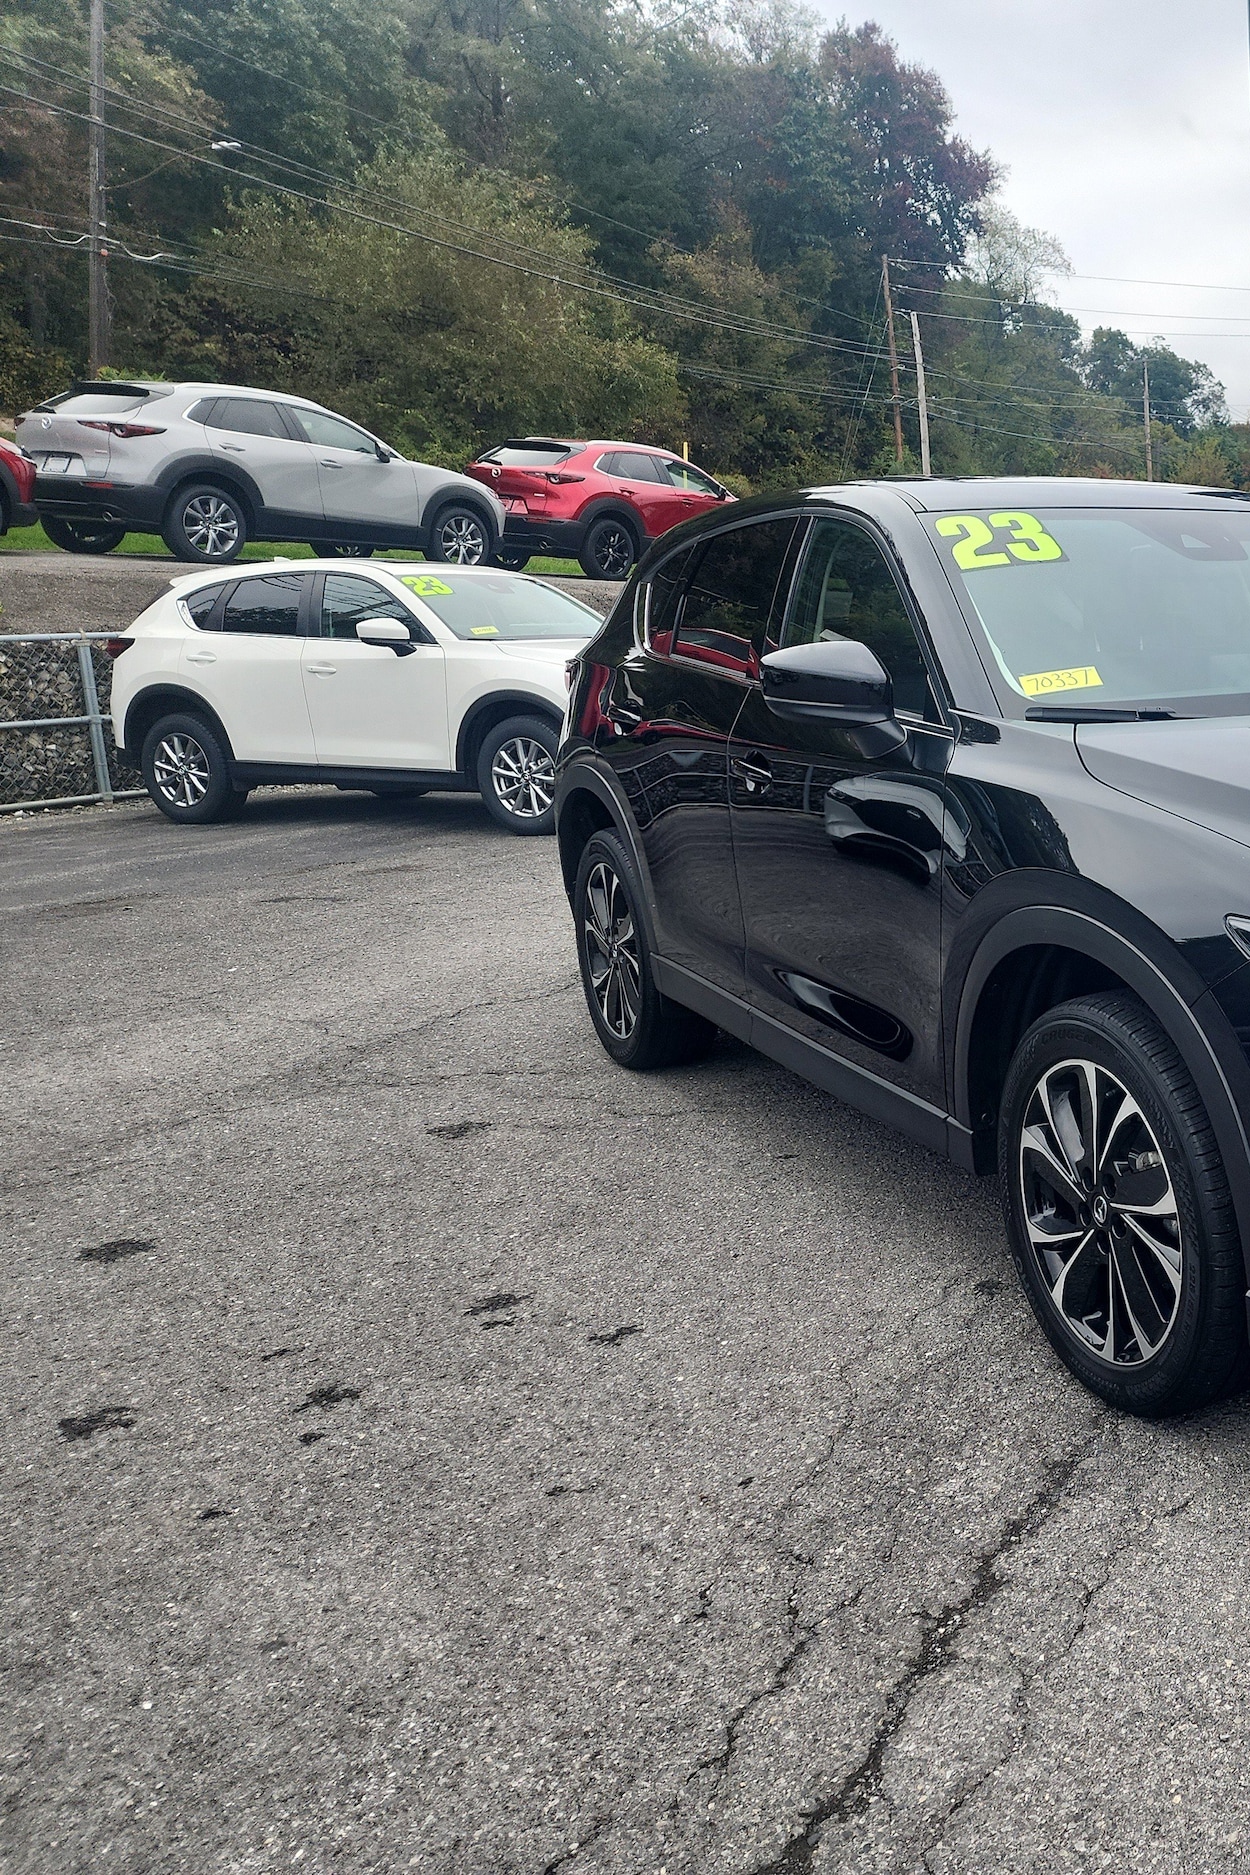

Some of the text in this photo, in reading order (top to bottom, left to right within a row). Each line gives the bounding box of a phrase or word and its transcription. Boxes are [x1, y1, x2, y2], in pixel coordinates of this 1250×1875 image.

[934, 511, 1062, 570] 23
[401, 575, 454, 597] 23
[1026, 668, 1092, 692] 70337
